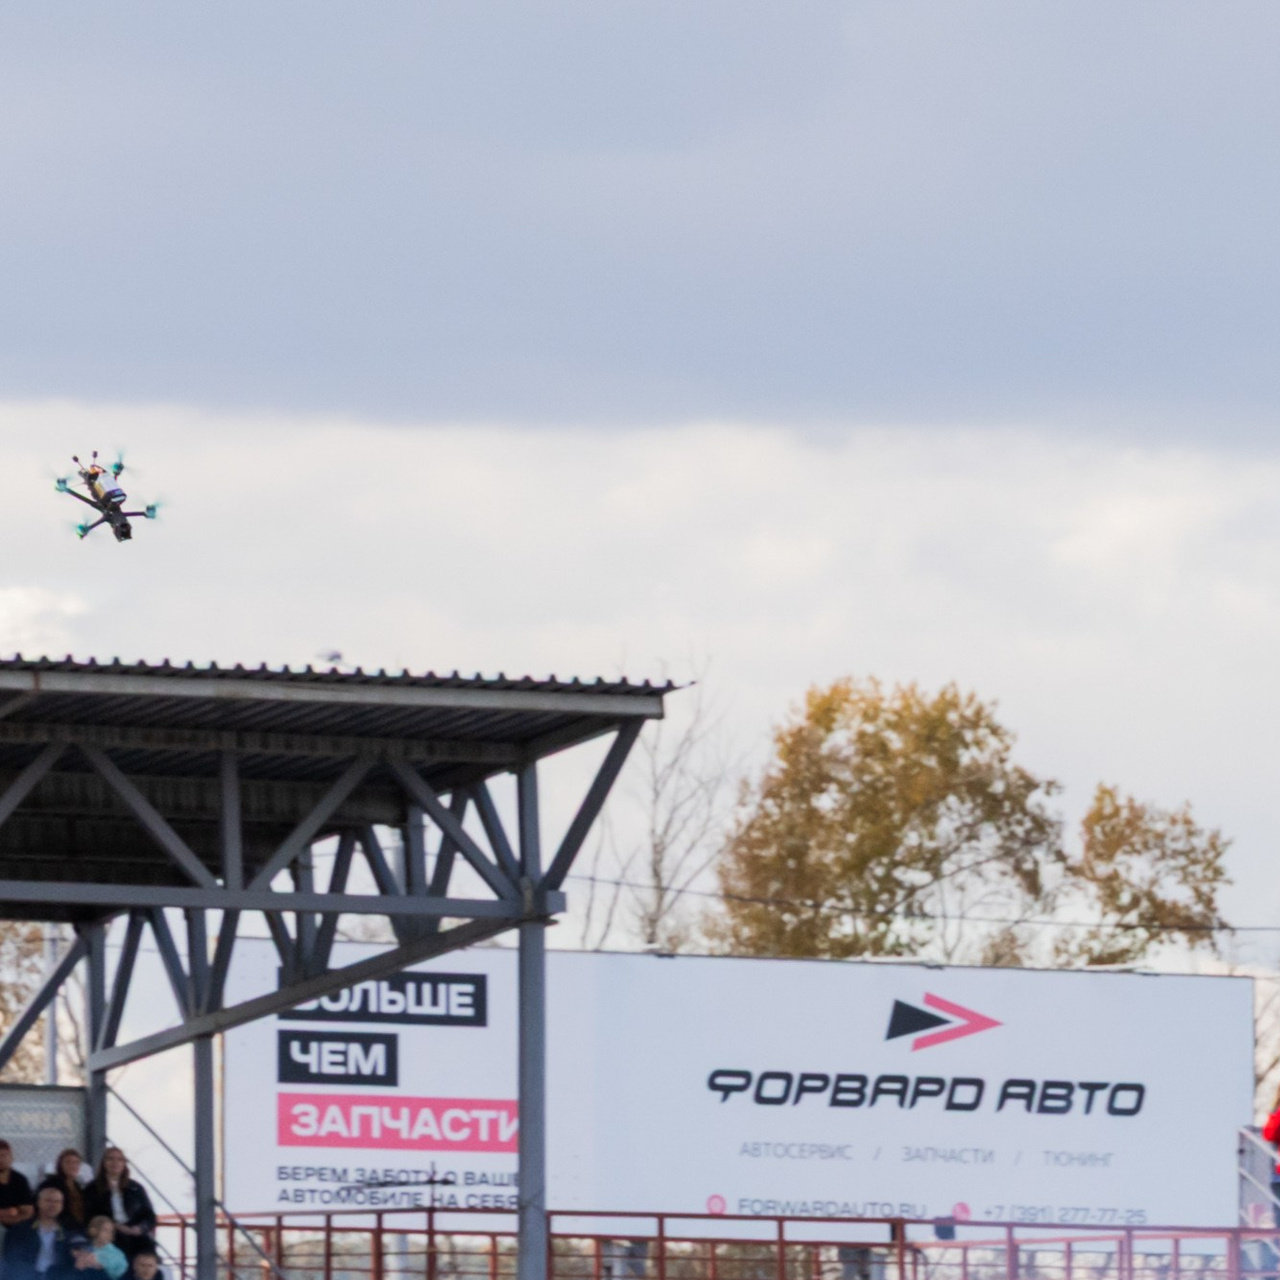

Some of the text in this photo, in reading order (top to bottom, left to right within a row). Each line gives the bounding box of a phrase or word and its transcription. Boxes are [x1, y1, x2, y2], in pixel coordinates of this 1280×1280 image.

[293, 979, 475, 1016] ОЛЬШЕ
[290, 1040, 387, 1076] ЧЕМ
[996, 1078, 1146, 1117] АВТО
[739, 1141, 854, 1161] АВТОСЕРВИС
[902, 1146, 995, 1165] ЗАПЧАСТИ
[1044, 1150, 1115, 1168] ТЮНИНГ
[277, 1165, 349, 1183] БЕРЕМ
